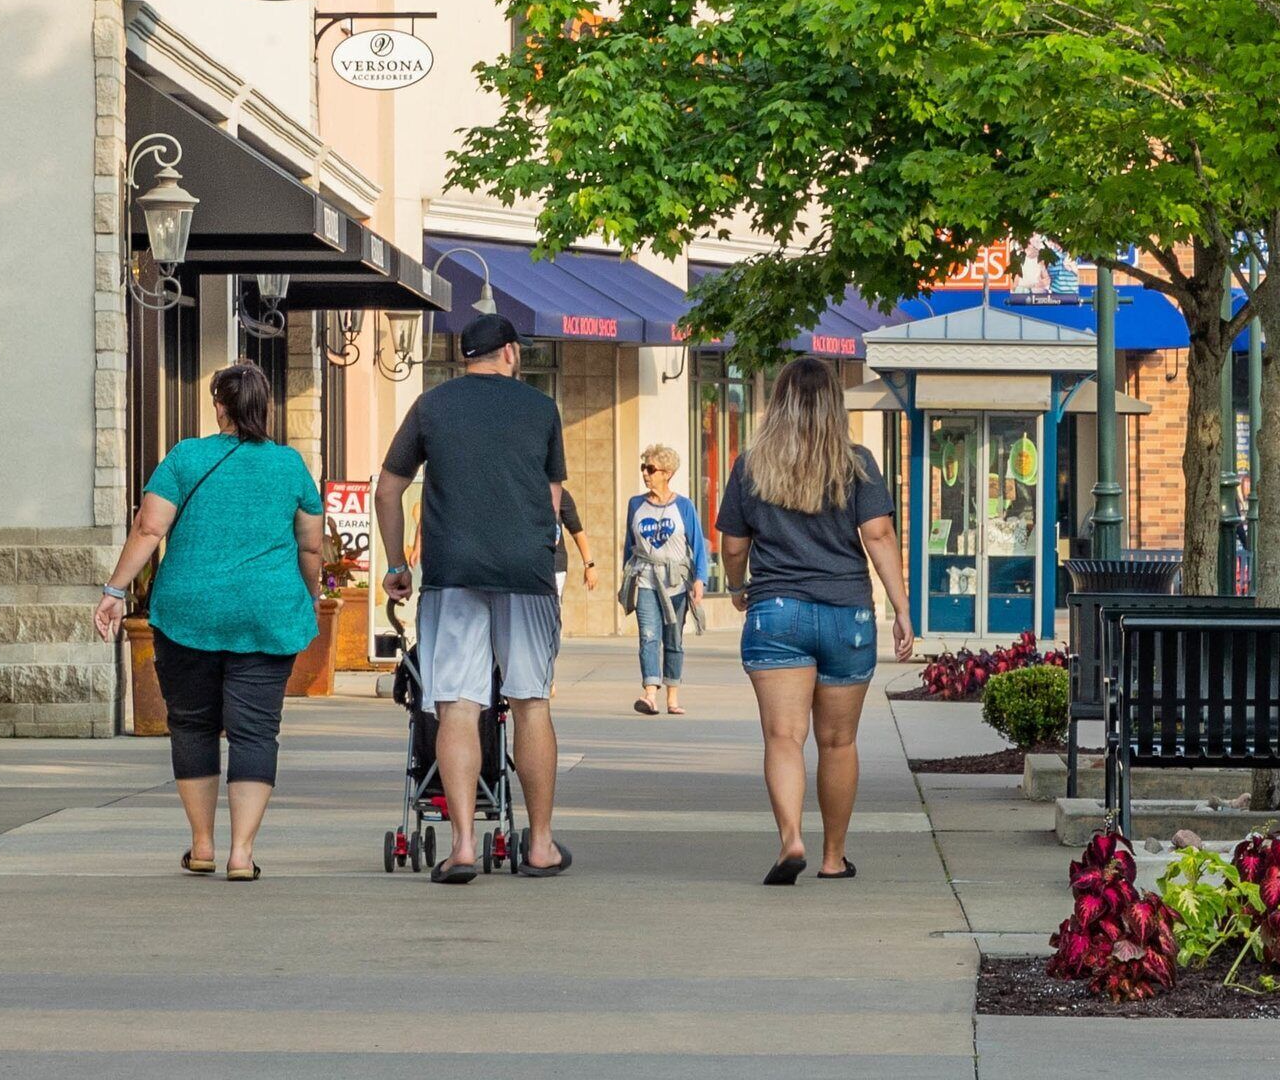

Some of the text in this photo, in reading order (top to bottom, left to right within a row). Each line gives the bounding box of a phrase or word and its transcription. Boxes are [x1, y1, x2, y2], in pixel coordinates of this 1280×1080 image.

[340, 60, 424, 72] VERSONA
[562, 315, 617, 338] RACK ROOM SHOES
[812, 335, 856, 355] RACK ROOM SHOES
